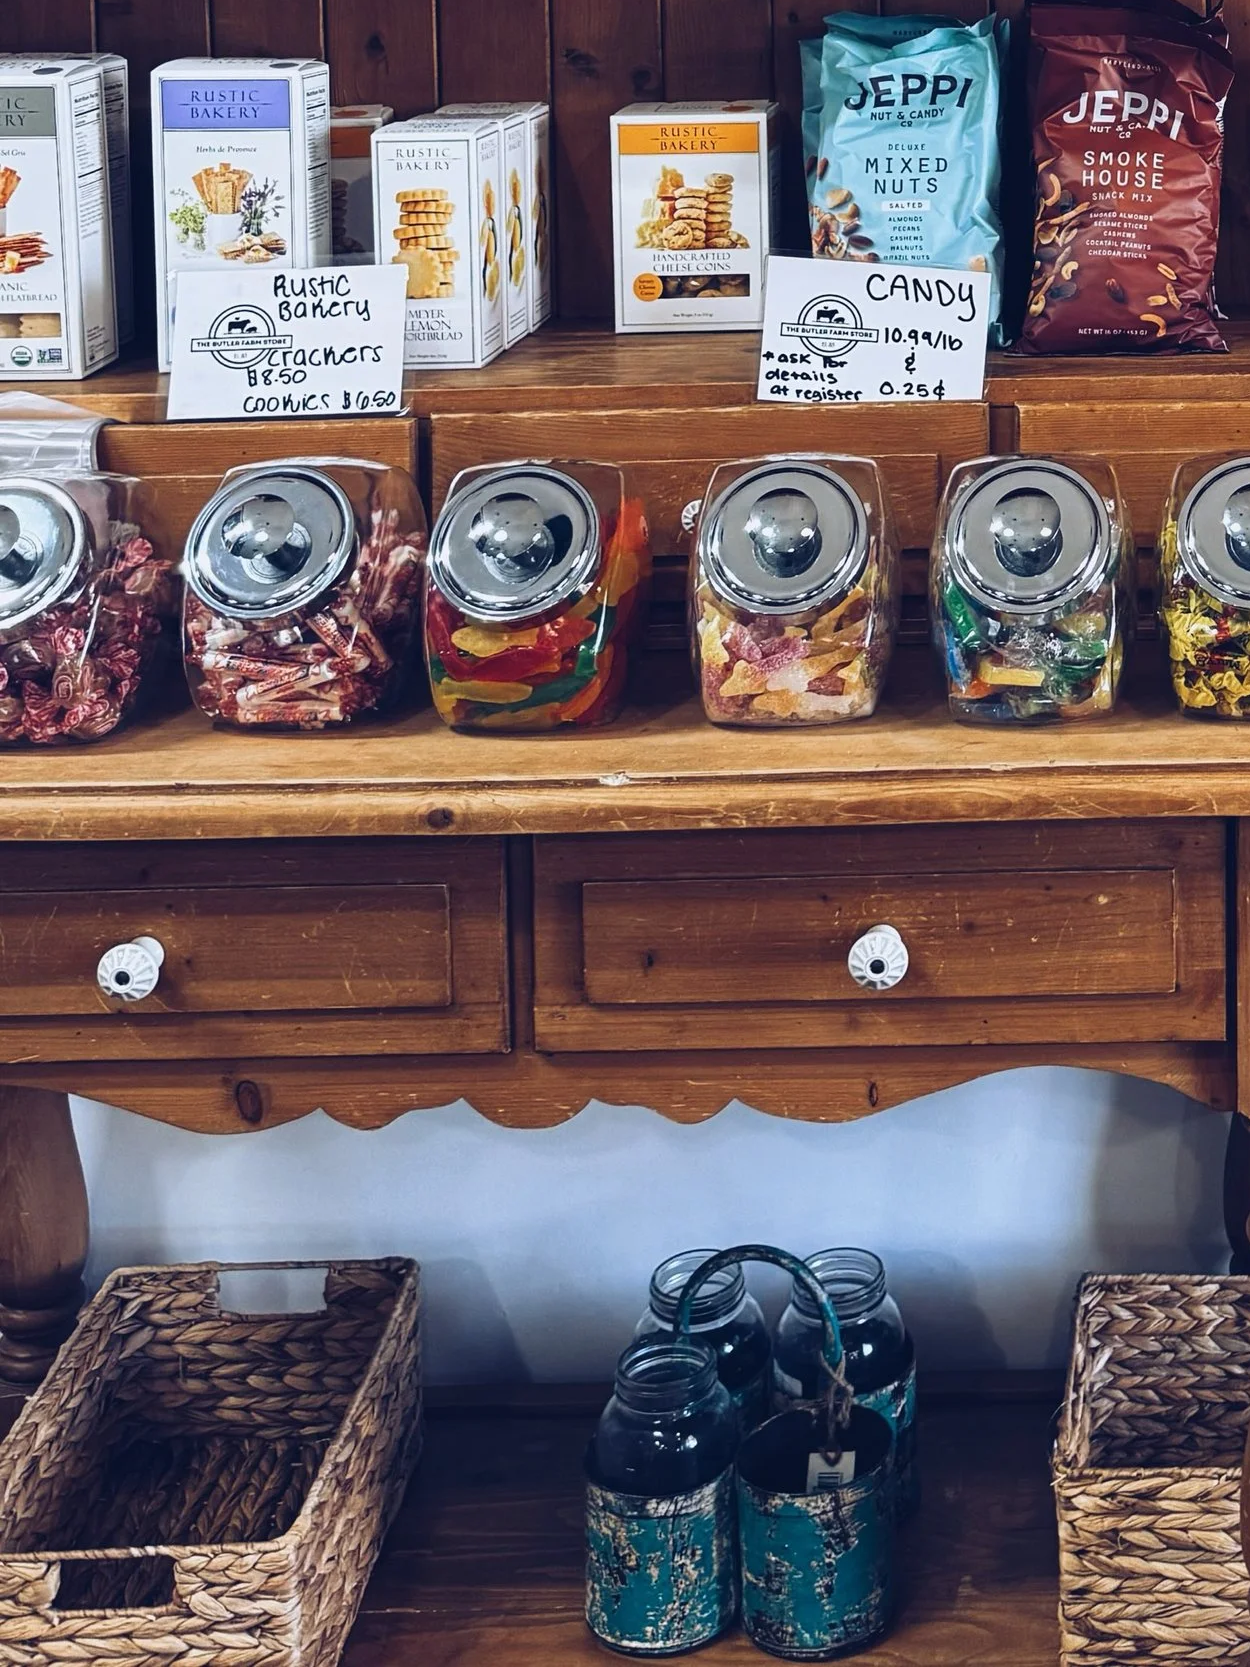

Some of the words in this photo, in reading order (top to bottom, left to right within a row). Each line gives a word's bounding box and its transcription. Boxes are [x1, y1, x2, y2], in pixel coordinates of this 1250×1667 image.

[190, 90, 260, 102] RUSTIC
[844, 73, 973, 110] JEPPI
[190, 106, 260, 119] BAKERY
[870, 110, 893, 121] NUT
[910, 108, 945, 120] CANDY
[1062, 89, 1185, 141] JEPPI
[660, 127, 718, 137] RUSTIC
[660, 140, 717, 151] BAKERY
[888, 143, 926, 151] DELUXE
[396, 148, 450, 158] RUSTIC
[865, 157, 949, 174] MIXED
[1083, 150, 1165, 169] SMOKE
[396, 161, 451, 171] BAKERY
[1083, 170, 1164, 189] HOUSE
[874, 178, 939, 195] NUTS
[1092, 191, 1125, 202] SNACK
[1132, 193, 1153, 203] MIX
[1119, 213, 1153, 221] ALMONDS
[1103, 230, 1136, 238] CASHEWS
[1121, 241, 1152, 250] PEANUTS
[653, 253, 730, 262] HANDCRAFTED
[1088, 249, 1121, 258] CHEDDAR
[653, 263, 692, 272] CHEESE
[696, 263, 731, 271] COINS
[273, 274, 351, 298] Rustic
[867, 274, 976, 322] CANDY
[278, 299, 370, 321] Bakery
[409, 309, 444, 319] MEYER
[404, 320, 451, 330] LEMON
[801, 327, 828, 335] BUTLER
[765, 369, 838, 384] details
[770, 384, 789, 396] at
[796, 387, 863, 402] register
